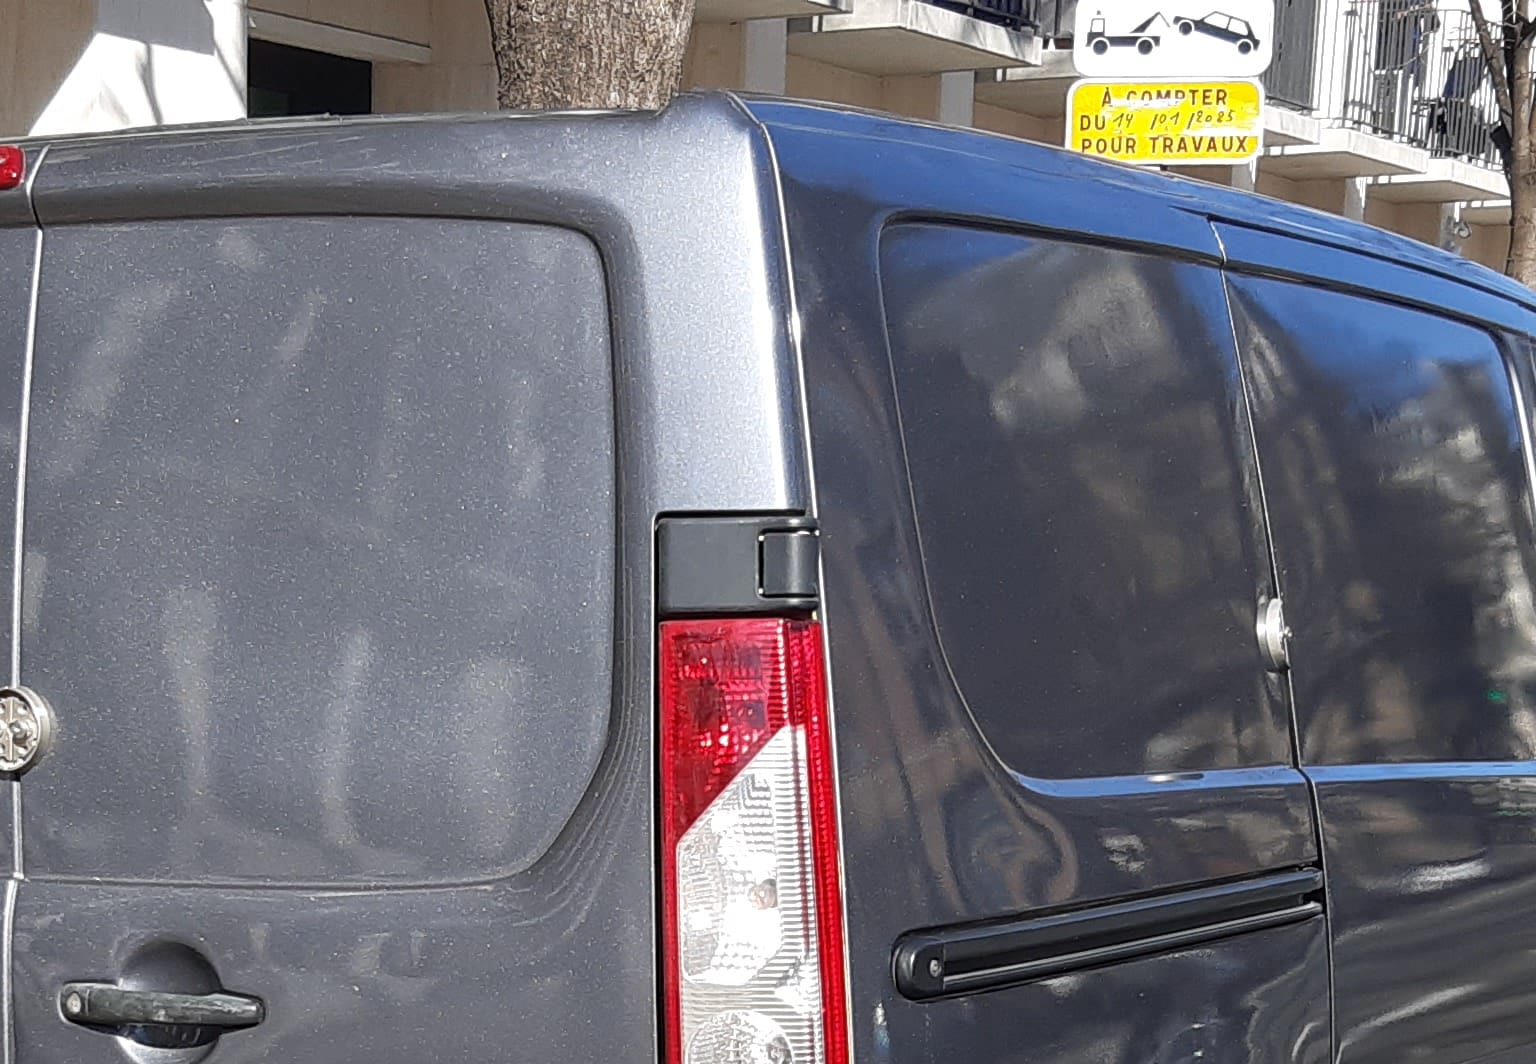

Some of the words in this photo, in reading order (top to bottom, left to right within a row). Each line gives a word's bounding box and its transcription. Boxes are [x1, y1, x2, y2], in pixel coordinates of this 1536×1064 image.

[1101, 86, 1112, 107] À
[1126, 89, 1227, 106] COMPTER
[1079, 114, 1106, 131] DU
[1081, 136, 1137, 153] POUR
[1149, 135, 1248, 153] TRAVAUX
